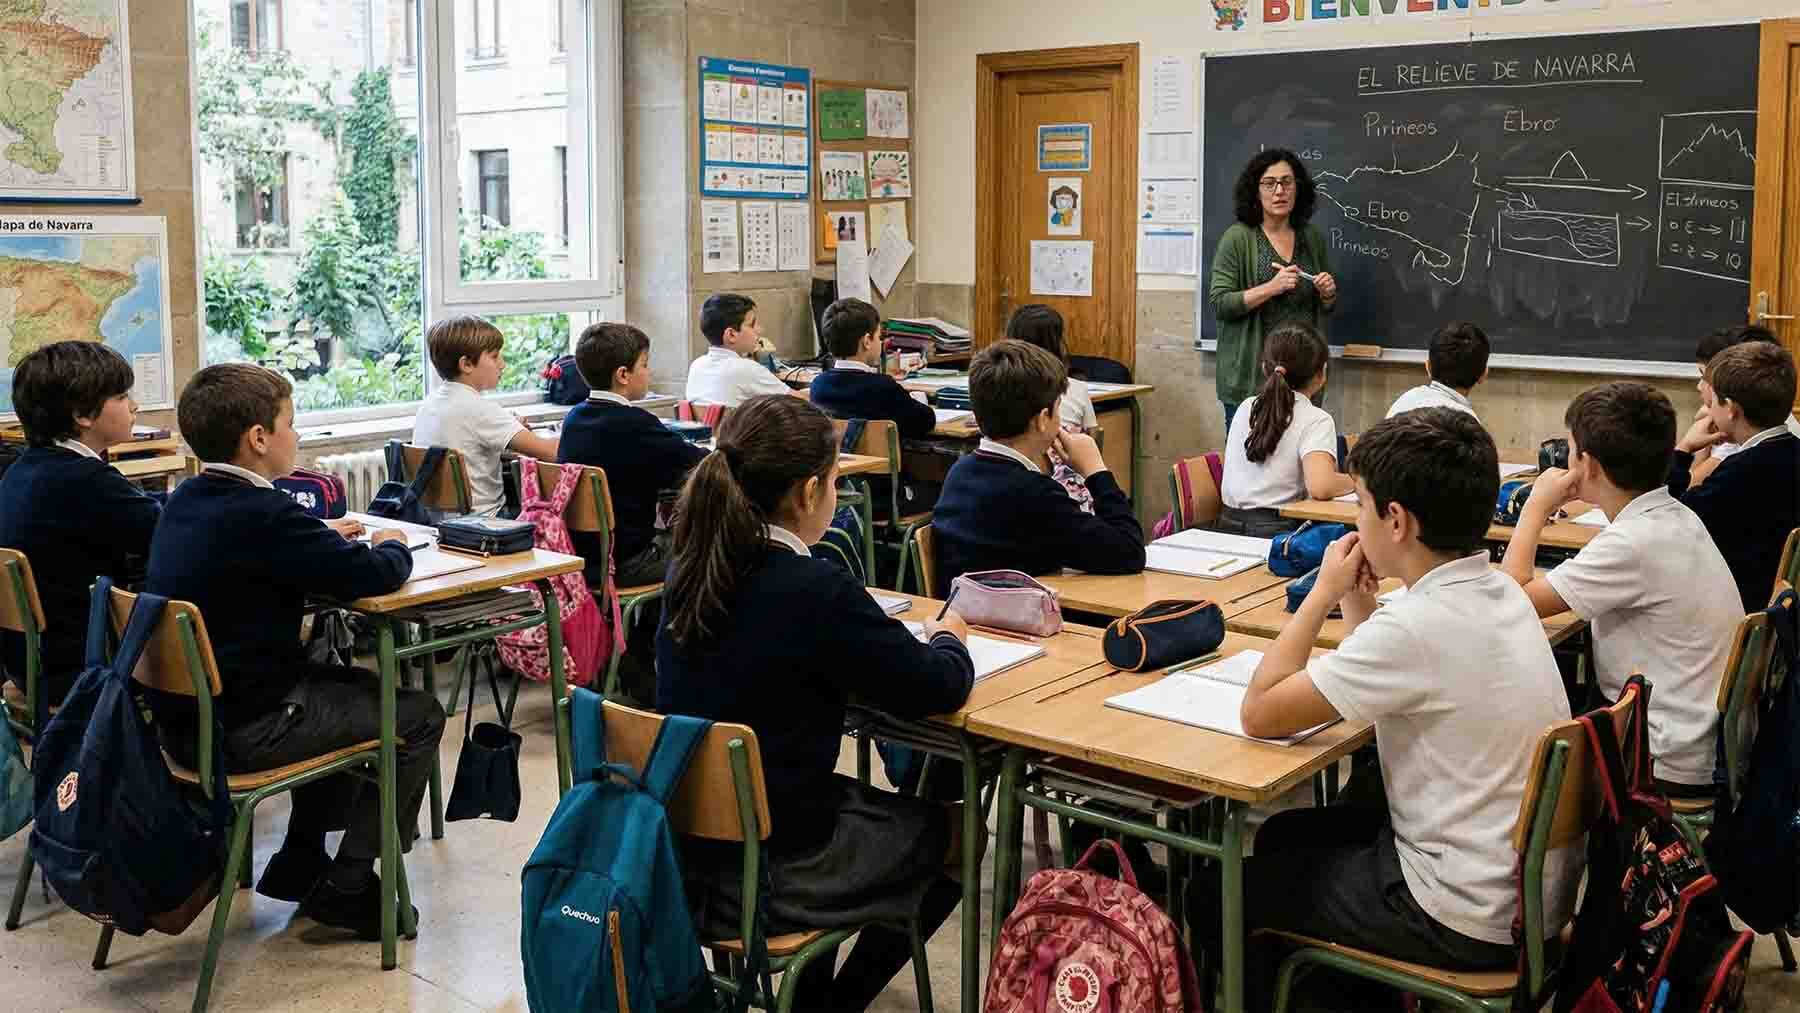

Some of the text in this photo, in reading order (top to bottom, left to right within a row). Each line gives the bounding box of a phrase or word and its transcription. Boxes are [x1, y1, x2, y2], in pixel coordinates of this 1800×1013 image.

[1358, 66, 1383, 88] EL
[1492, 60, 1520, 81] DE
[1534, 52, 1636, 78] NAVARRA
[1363, 111, 1438, 137] Pirineos
[1503, 108, 1557, 131] Ebro
[1368, 200, 1409, 222] Ebro
[0, 219, 93, 232] apa de Navarra
